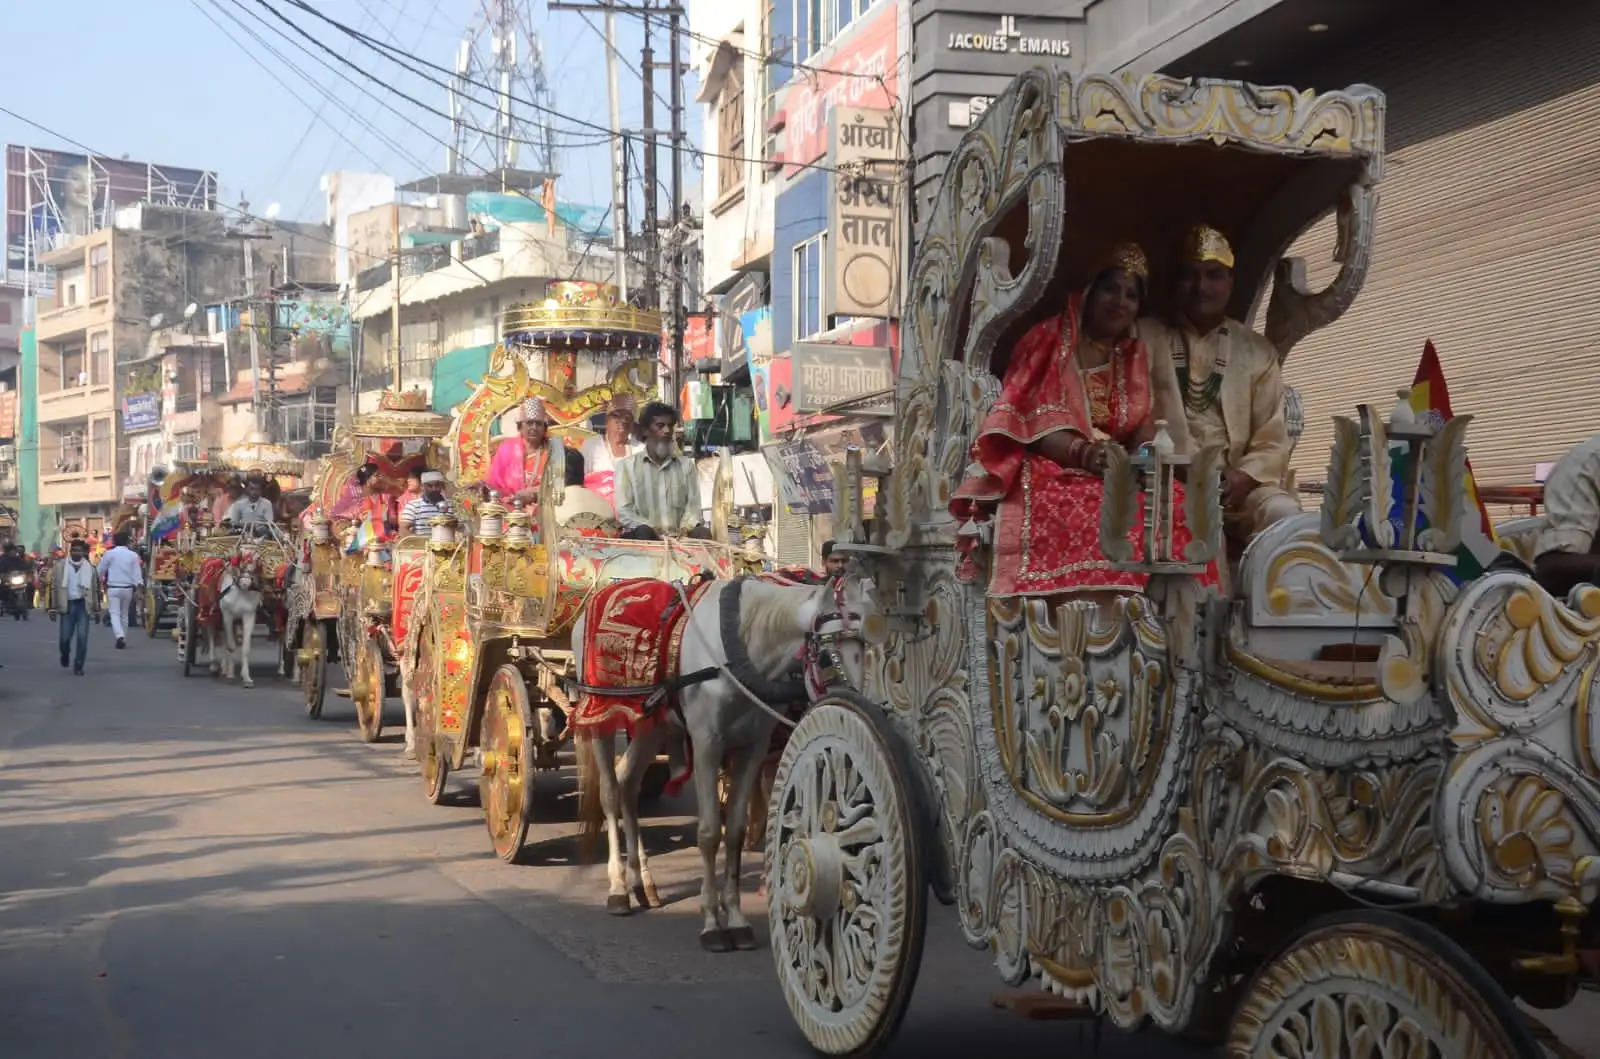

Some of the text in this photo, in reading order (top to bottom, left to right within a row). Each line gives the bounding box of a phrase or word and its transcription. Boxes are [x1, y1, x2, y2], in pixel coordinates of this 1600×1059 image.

[947, 32, 1071, 56] JACQUES EMANS
[841, 214, 894, 248] ताल
